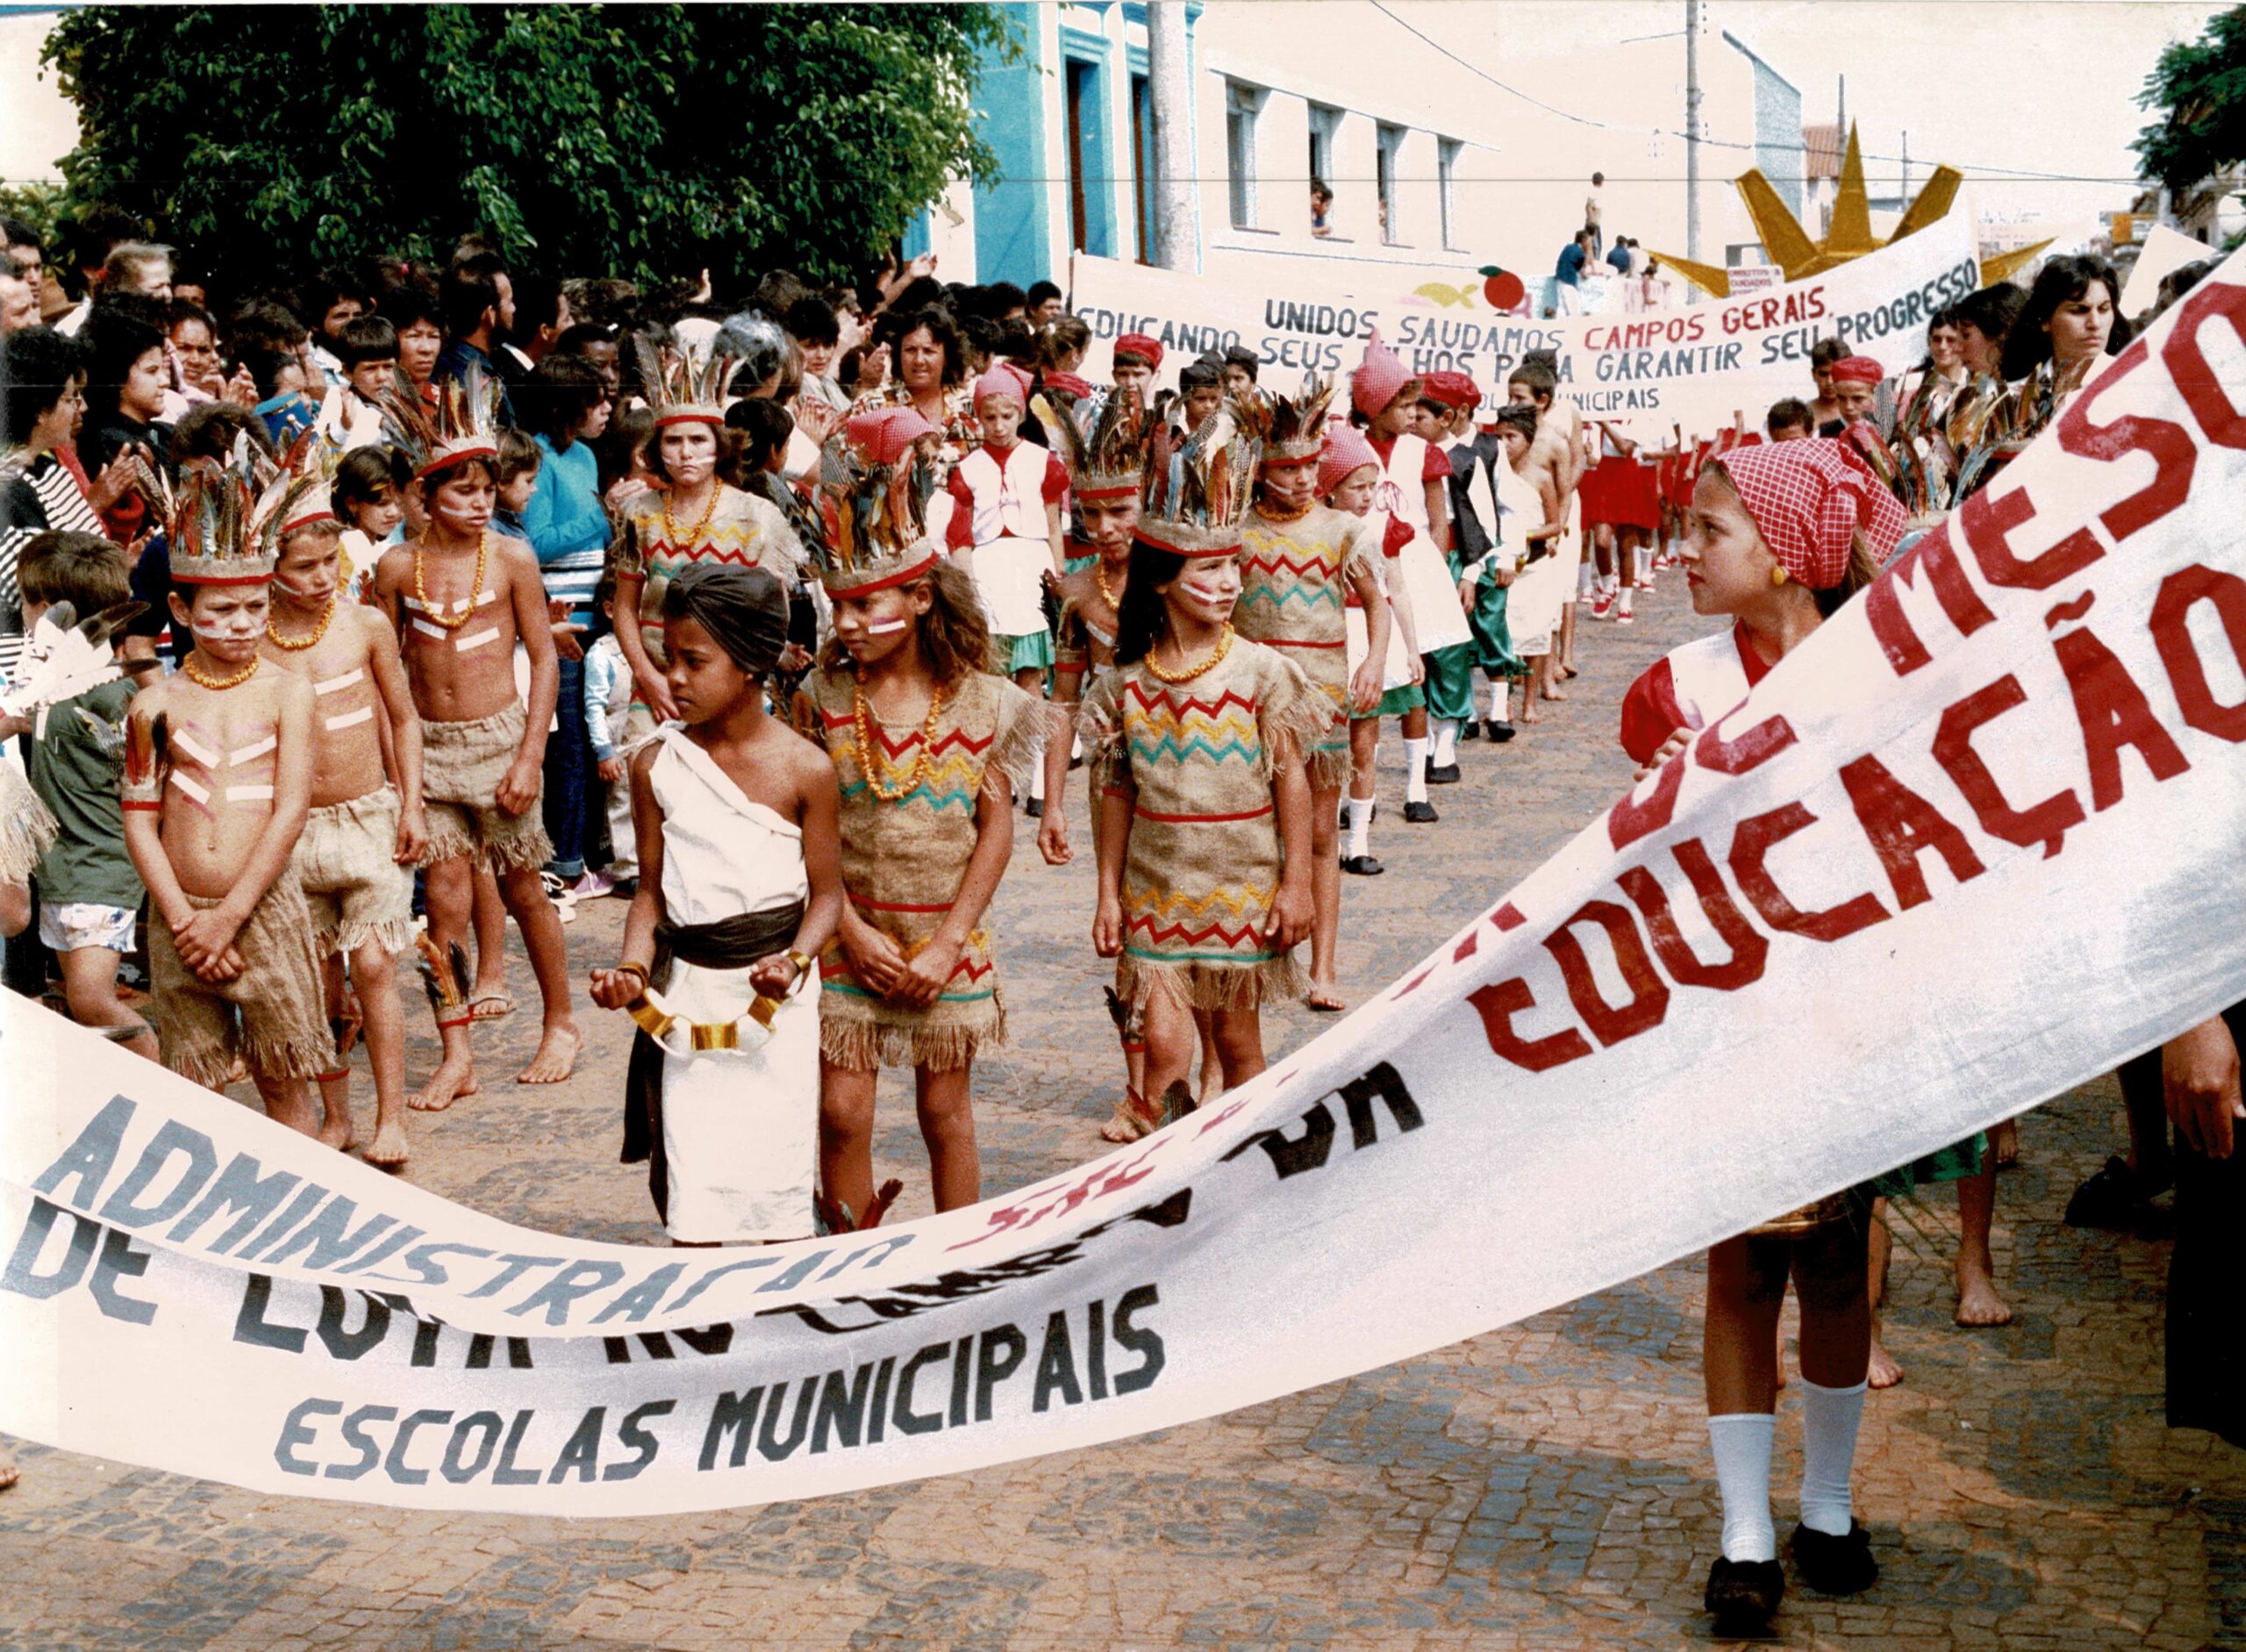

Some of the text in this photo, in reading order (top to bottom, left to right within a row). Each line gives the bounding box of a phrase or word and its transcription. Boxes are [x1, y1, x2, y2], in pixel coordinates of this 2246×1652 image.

[1257, 337, 1343, 371] SEUS
[1595, 342, 1742, 382] GARANTIR
[1761, 325, 1819, 364] SEU
[1836, 257, 1978, 344] PROGRESSO
[1265, 299, 1378, 340] UNIDOS
[1398, 316, 1565, 353] SAUDAMOS
[1584, 313, 1705, 351] CAMPOS
[0, 1194, 158, 1326] DE
[1466, 562, 2246, 1072] EDUCAÇÃO
[274, 1284, 1166, 1485] ESCOLAS MUNICIPAIS
